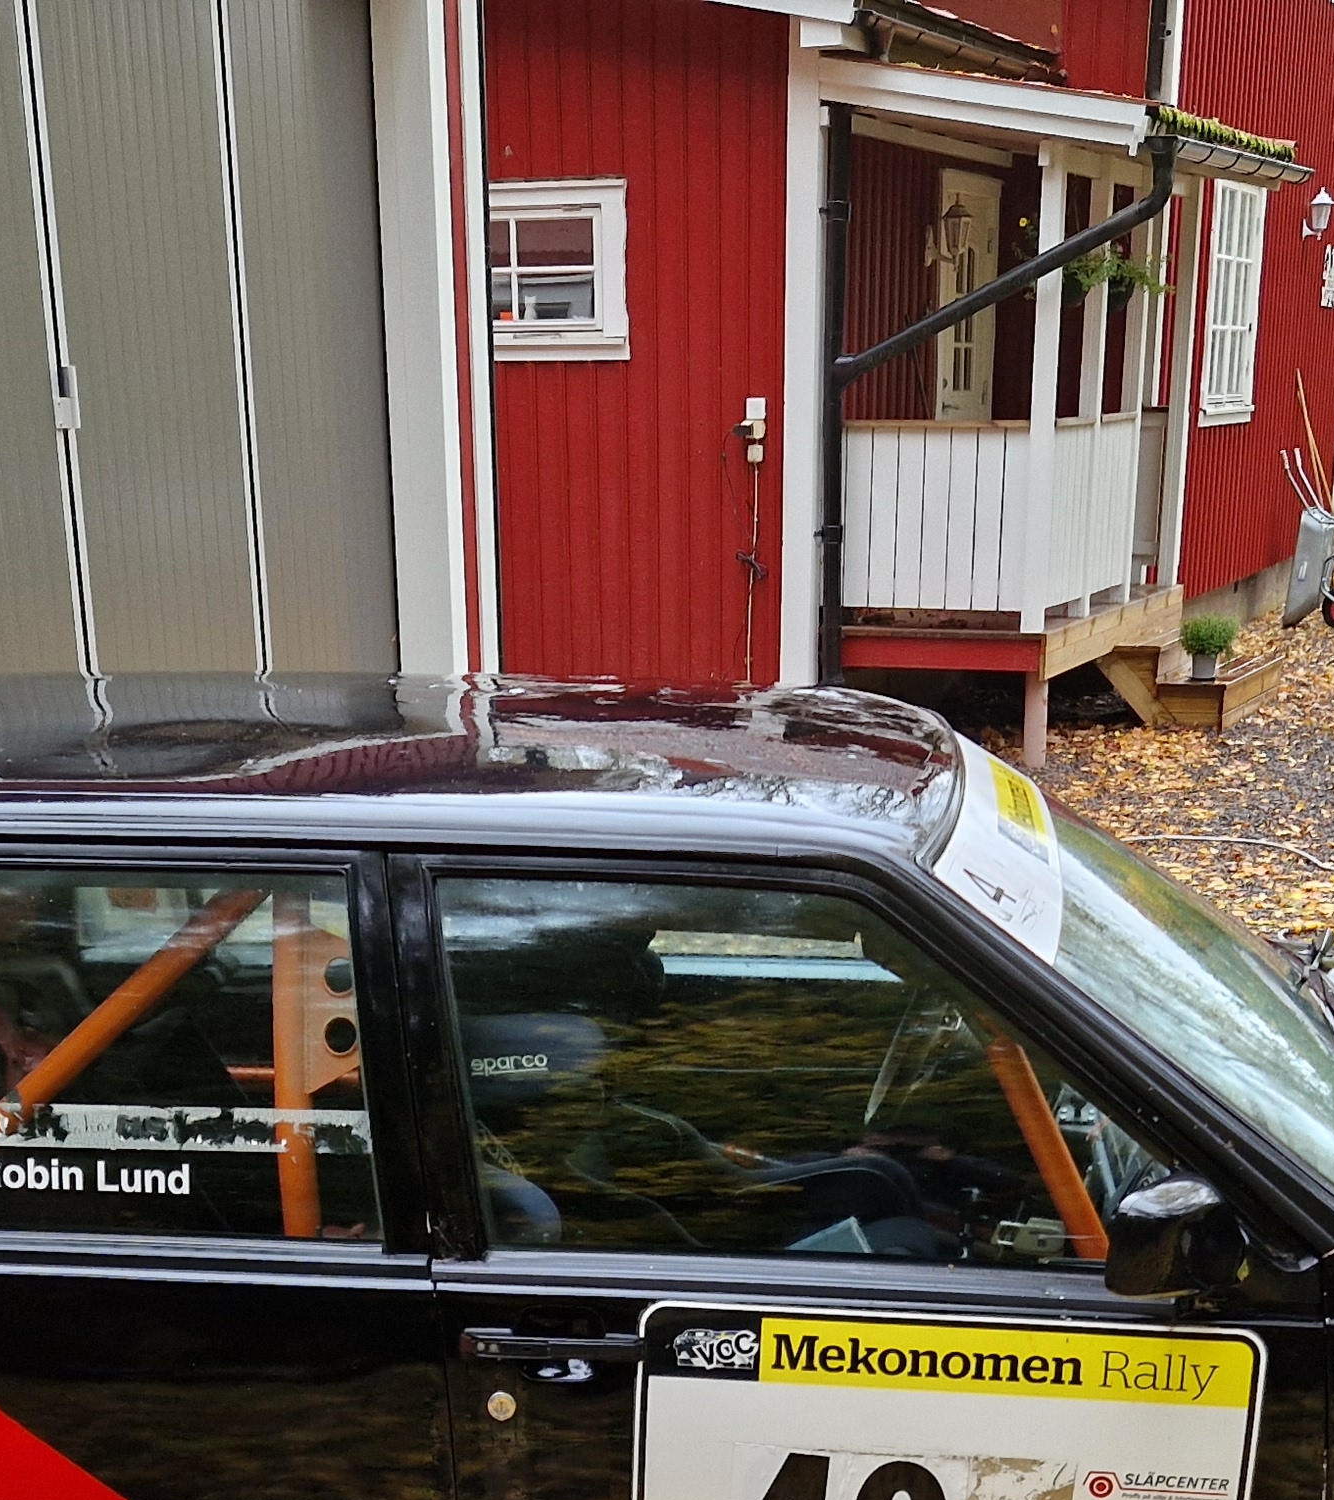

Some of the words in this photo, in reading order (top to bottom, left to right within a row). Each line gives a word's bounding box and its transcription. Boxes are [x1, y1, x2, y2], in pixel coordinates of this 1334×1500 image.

[471, 1054, 548, 1077] sparco
[96, 1160, 190, 1195] Lund
[693, 1330, 759, 1370] VOC
[771, 1333, 1083, 1386] Mekonomen
[1098, 1350, 1220, 1400] Rally
[1124, 1471, 1230, 1491] SLÄPCENTER
